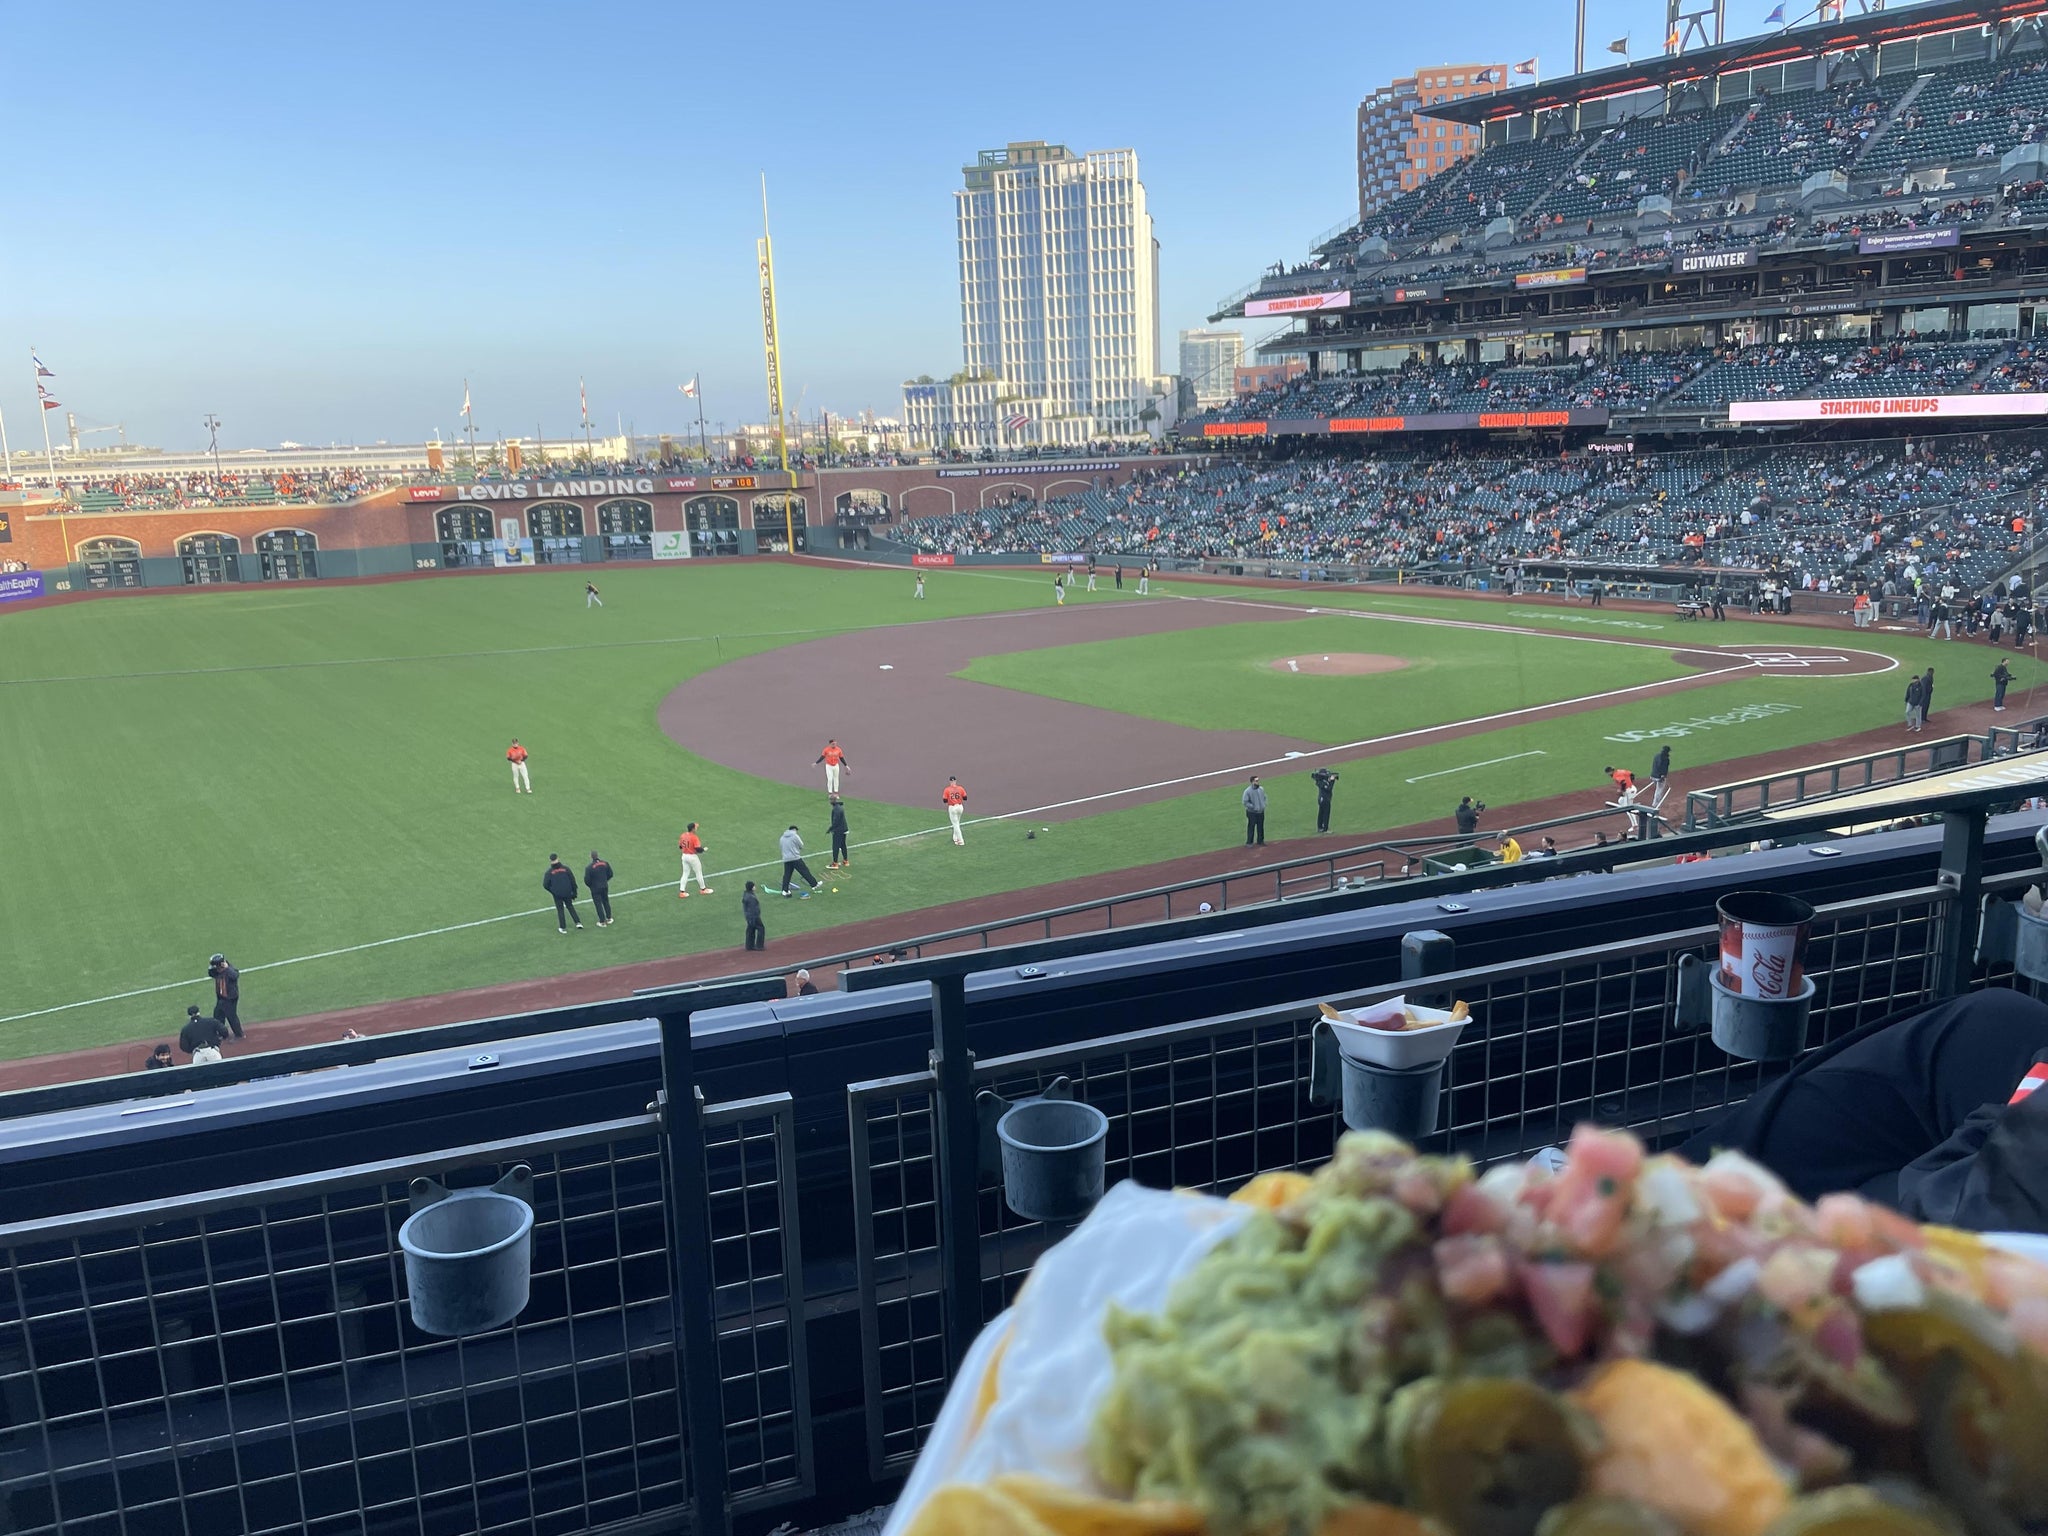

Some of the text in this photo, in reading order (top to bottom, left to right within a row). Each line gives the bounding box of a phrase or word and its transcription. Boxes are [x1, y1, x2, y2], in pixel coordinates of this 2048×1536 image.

[1682, 252, 1746, 271] CUTWATER
[1406, 289, 1427, 298] TOYOTA
[1268, 297, 1324, 311] STARTING LINEUPS
[1820, 398, 1939, 415] STARTING LINEUPS
[1329, 416, 1404, 432] STARTING LINEUPS
[1479, 411, 1569, 427] STARTING LINEUPS
[862, 421, 997, 434] BANK OF AMERICA
[1204, 422, 1267, 436] STARTING LINEUPS
[1601, 444, 1624, 452] Health
[537, 478, 654, 498] LANDING
[736, 478, 752, 487] 100
[771, 544, 788, 552] 309
[416, 560, 436, 568] 365
[55, 581, 71, 591] 415
[1671, 702, 1803, 730] Health
